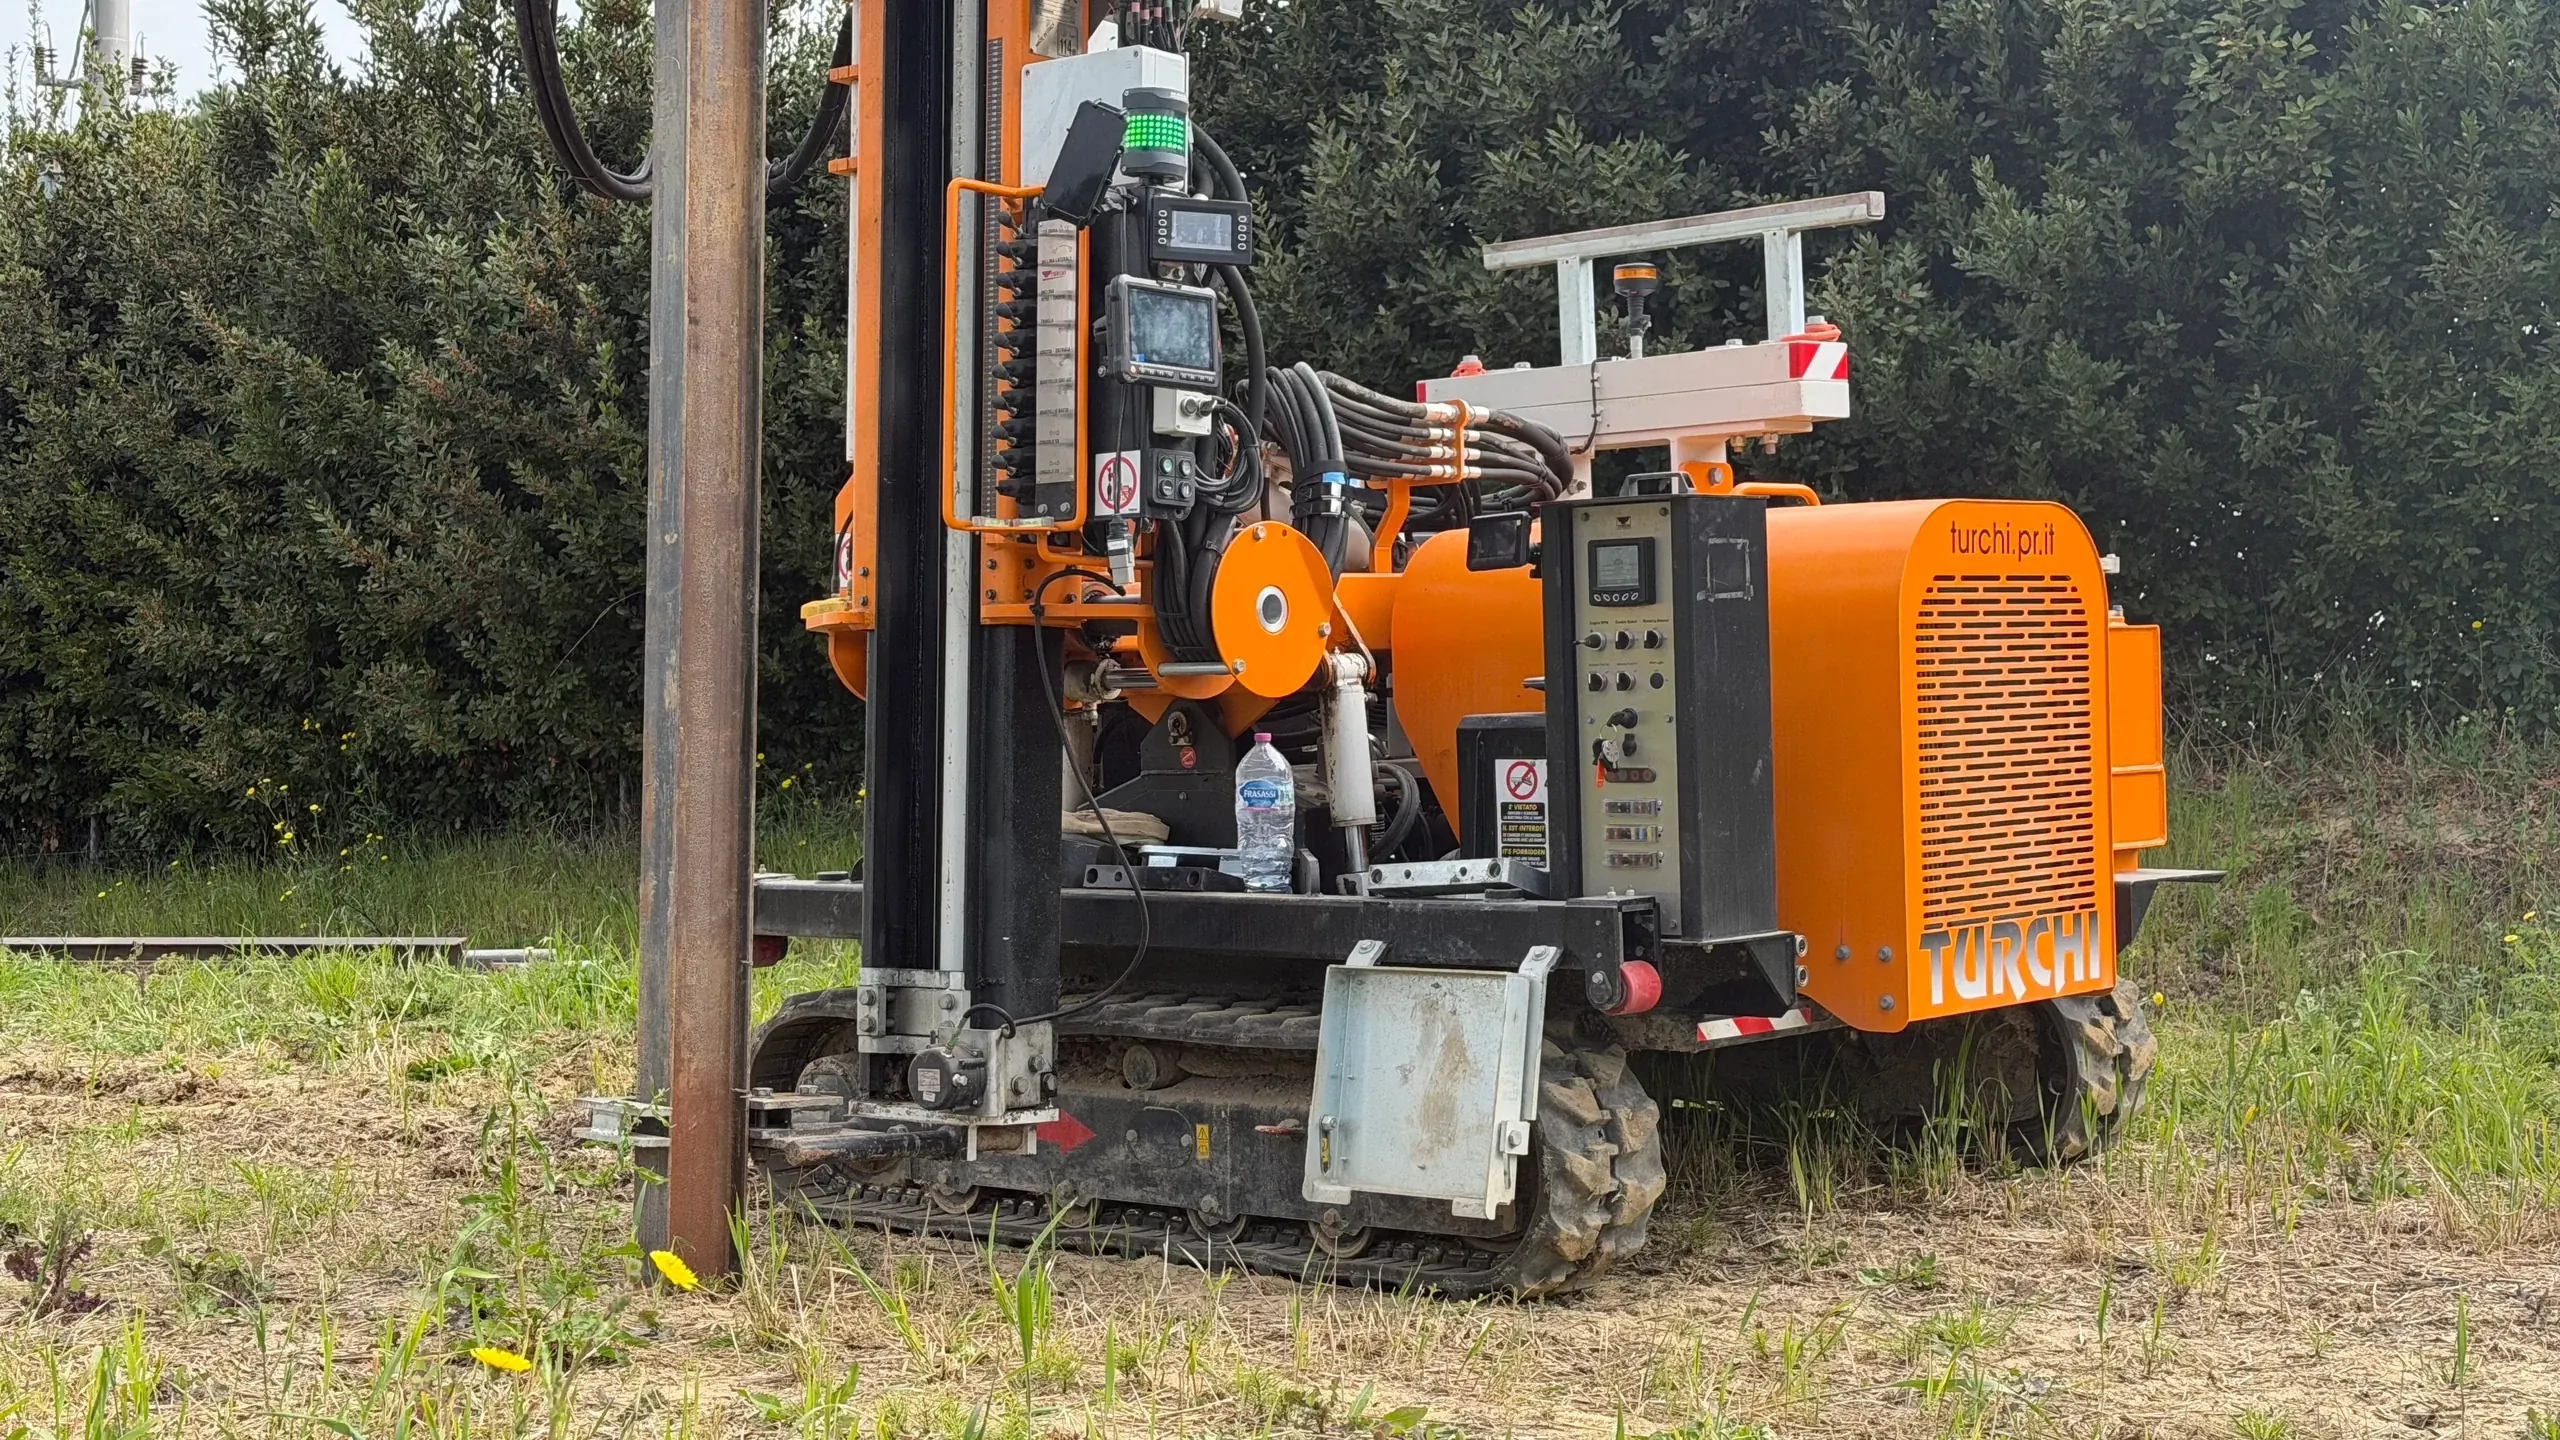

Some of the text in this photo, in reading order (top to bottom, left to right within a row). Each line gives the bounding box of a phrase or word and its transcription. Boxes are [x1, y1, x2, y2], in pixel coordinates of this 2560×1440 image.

[1950, 520, 2055, 562] turchi.pr.it
[1243, 789, 1276, 798] FRASASSI
[1919, 910, 2101, 1005] TURCHI
